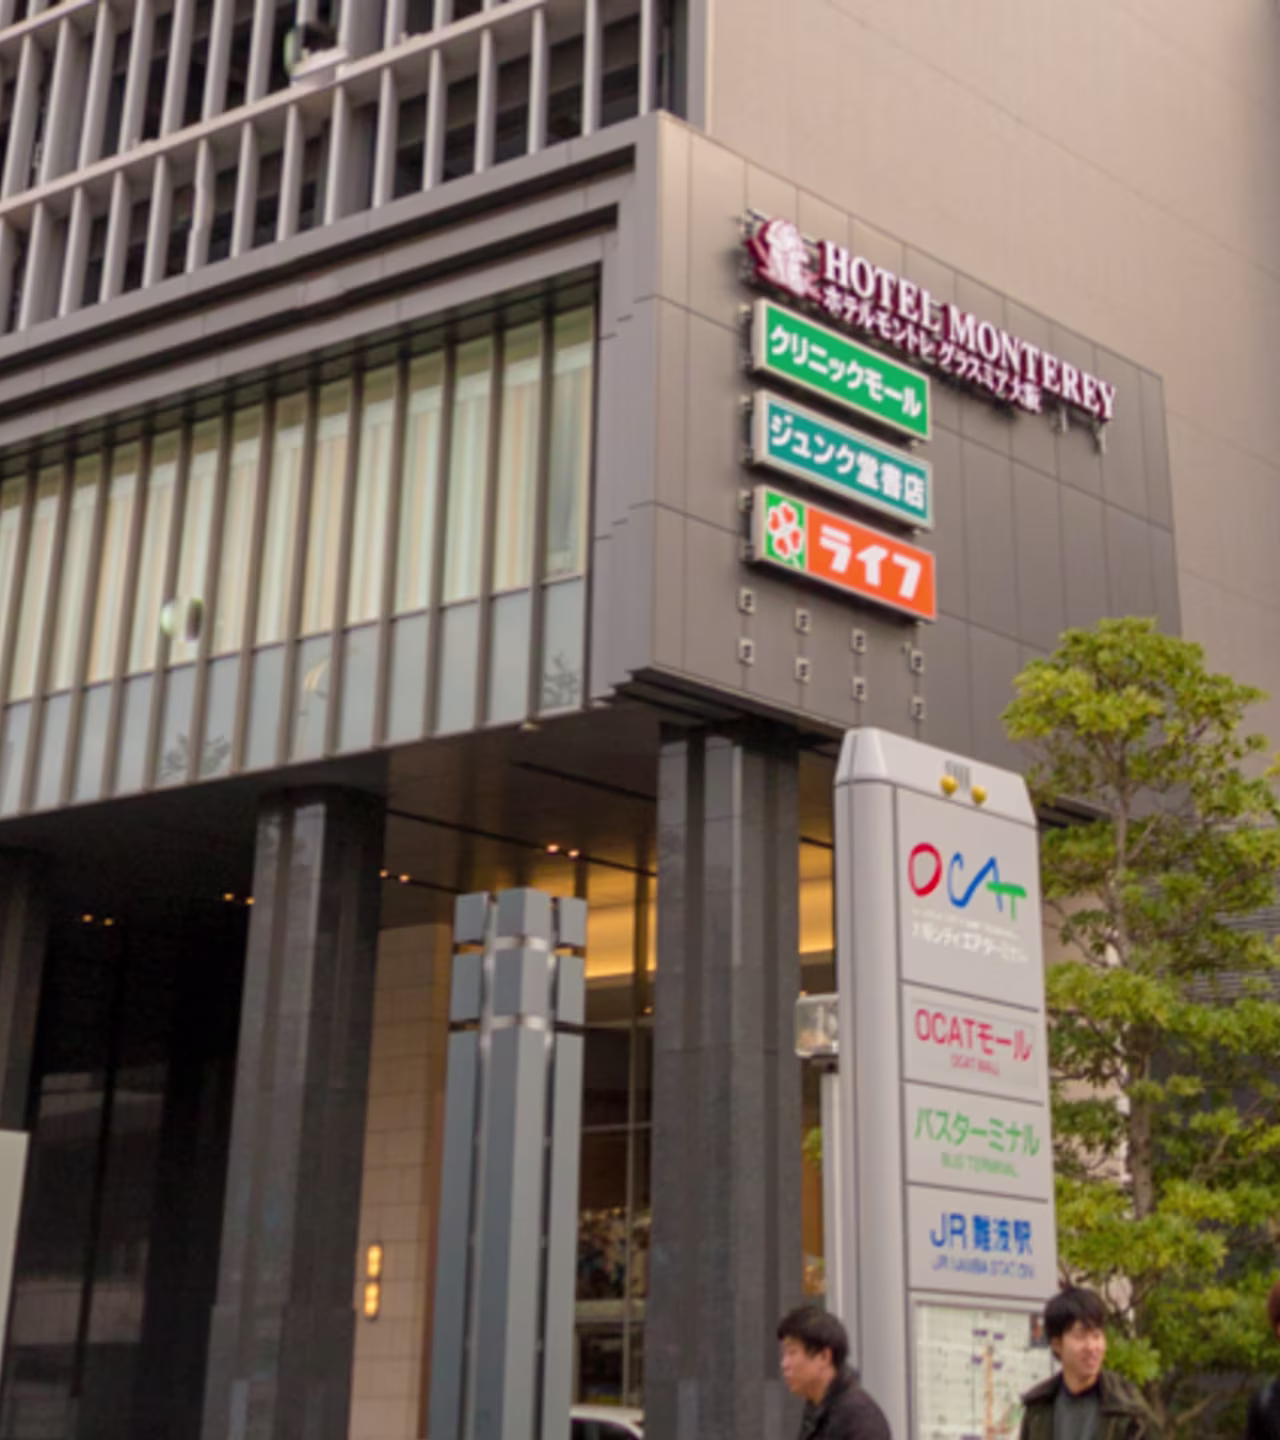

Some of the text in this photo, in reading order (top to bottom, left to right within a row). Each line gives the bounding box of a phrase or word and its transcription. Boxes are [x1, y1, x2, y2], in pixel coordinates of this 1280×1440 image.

[823, 240, 1116, 420] HOTEL MONTEREY
[769, 325, 923, 418] クリニックモール
[769, 412, 927, 508] ジュンク堂書店
[819, 522, 923, 600] ライフ
[907, 841, 1028, 922] OCAT
[914, 1008, 1033, 1062] OCATモール
[914, 1106, 1040, 1158] バスターミナル
